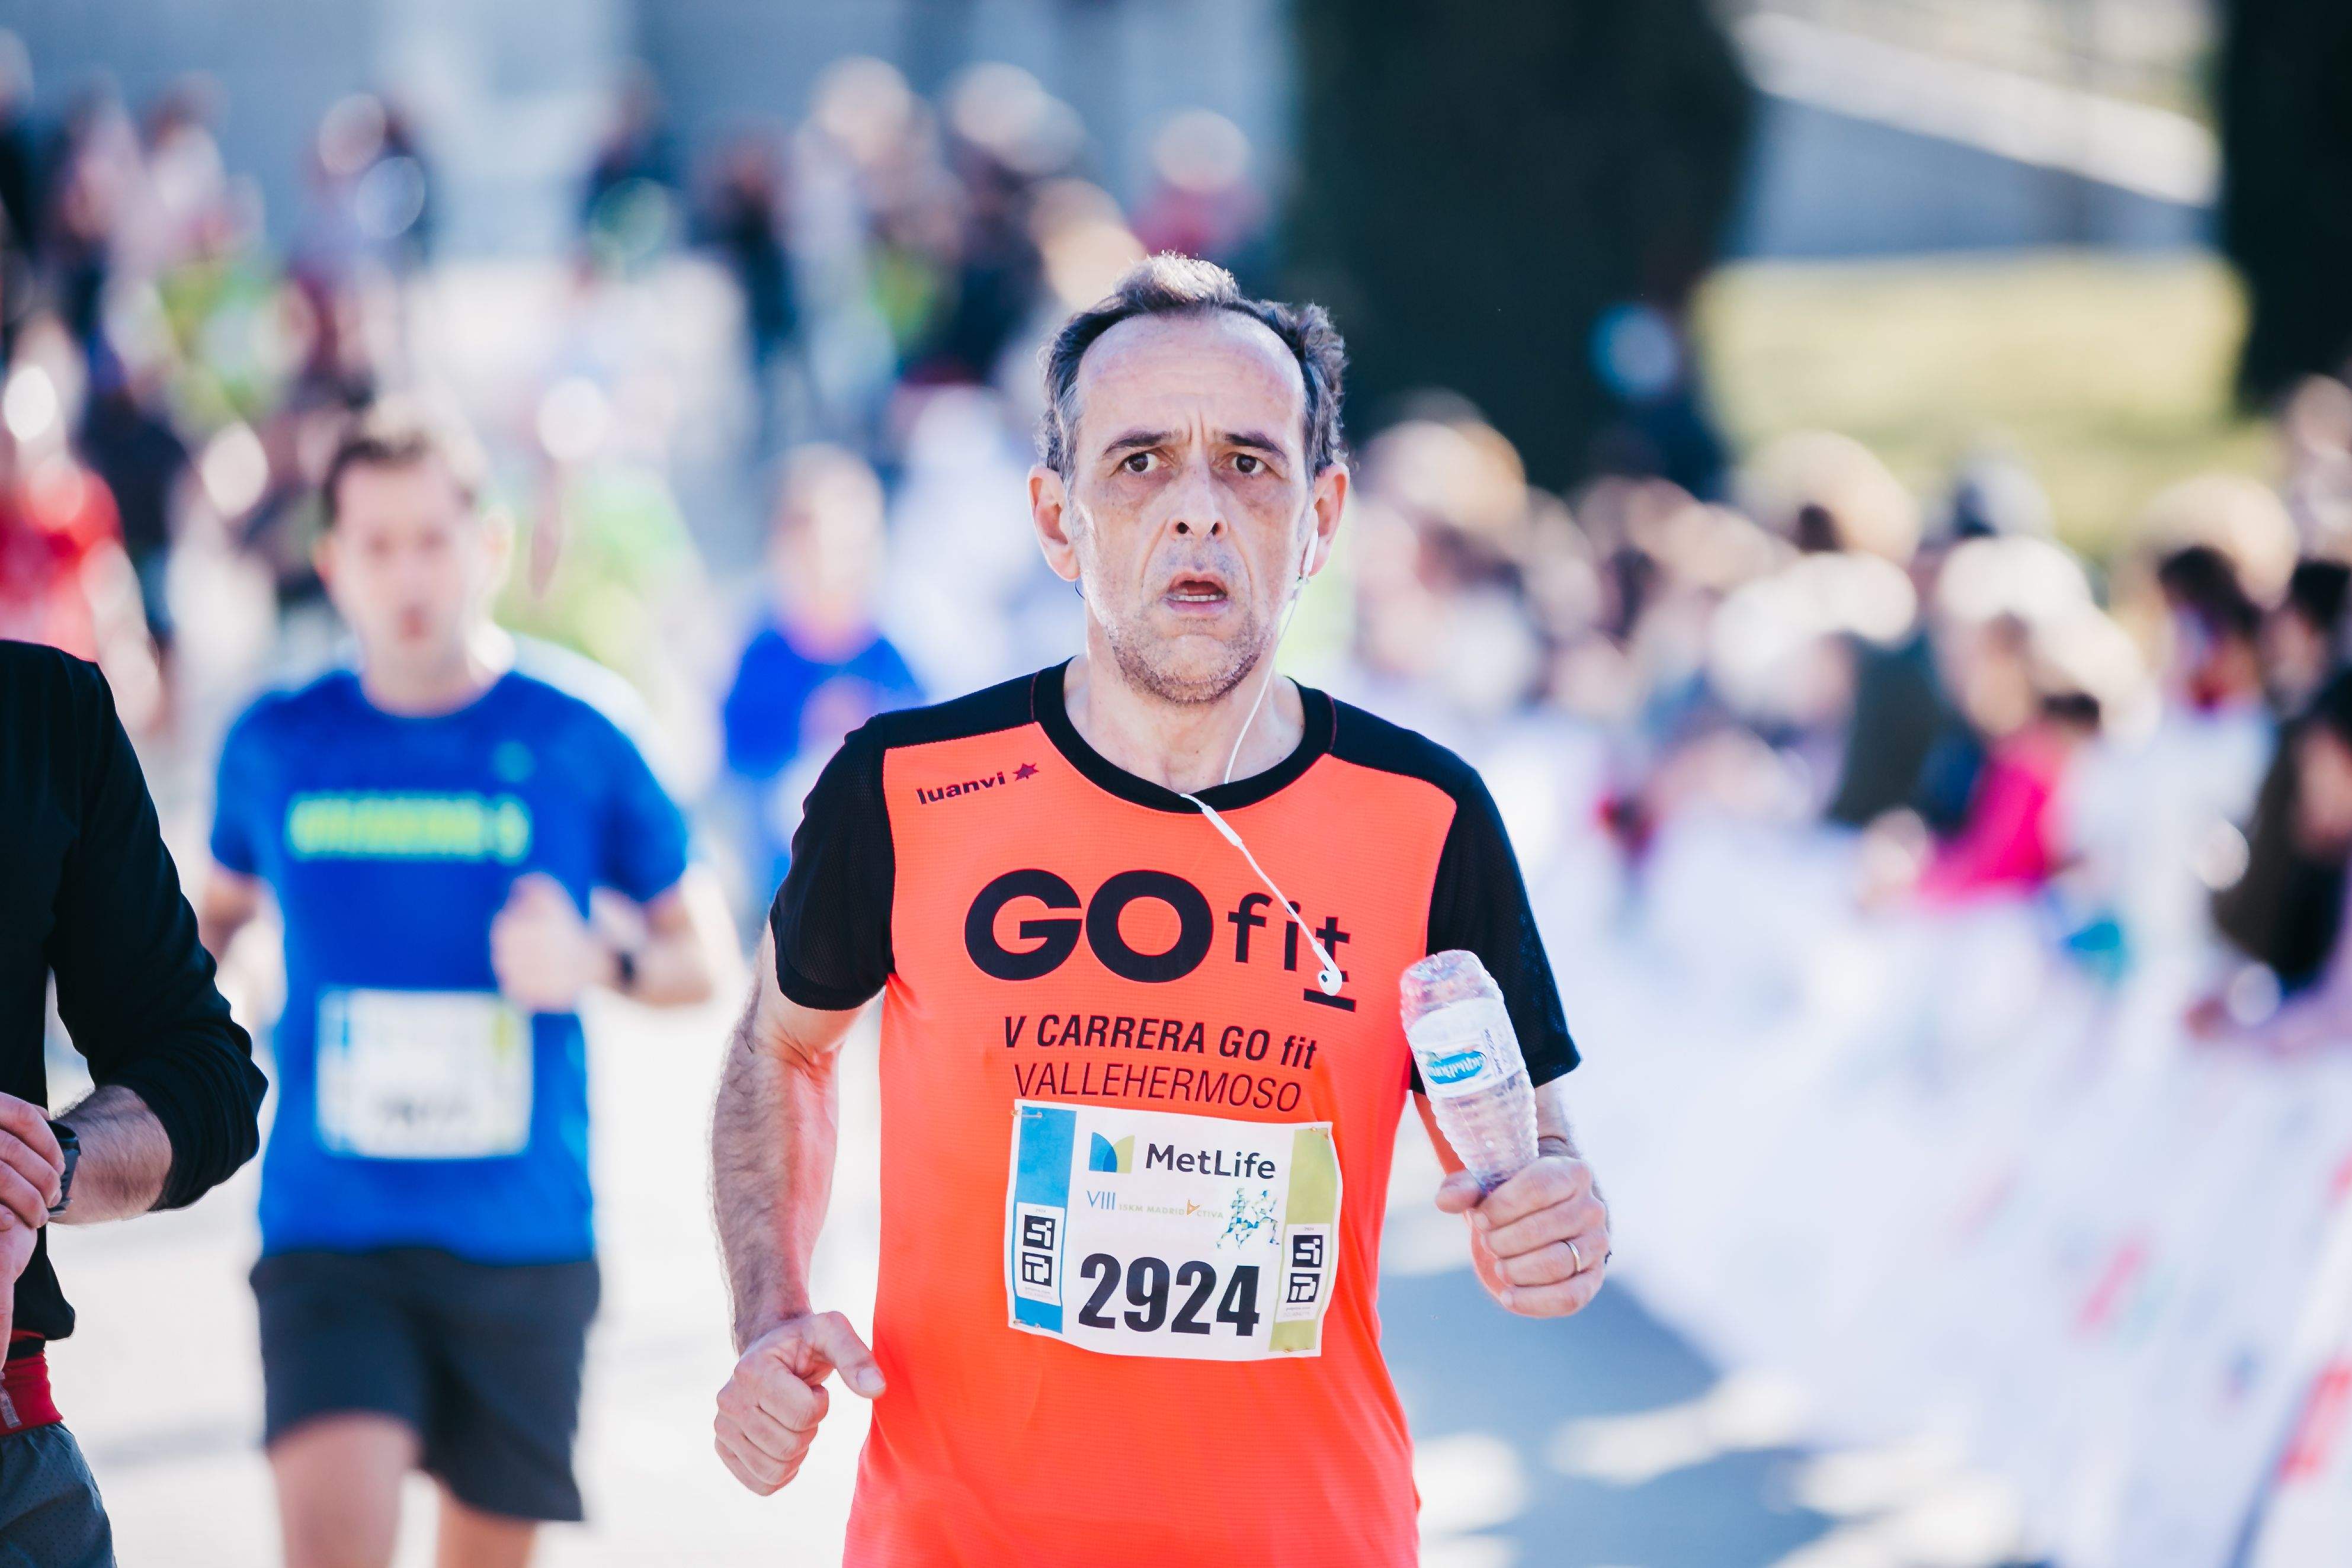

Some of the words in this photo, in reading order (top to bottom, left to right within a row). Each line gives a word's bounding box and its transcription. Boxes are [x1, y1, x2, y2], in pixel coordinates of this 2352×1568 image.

[916, 771, 1006, 806] luanvi
[964, 868, 1213, 984] GO
[1227, 892, 1351, 985] fit
[1005, 1015, 1027, 1048] V
[1037, 1014, 1204, 1054] CARRERA
[1219, 1025, 1270, 1061] GO
[1280, 1035, 1317, 1070] fit
[1014, 1063, 1301, 1112] VALLEHERMOSO
[1146, 1143, 1276, 1180] MetLife
[1086, 1189, 1116, 1210] VIII
[1119, 1203, 1144, 1212] 15KM
[1146, 1205, 1184, 1216] MADRID
[1078, 1252, 1261, 1337] 2924
